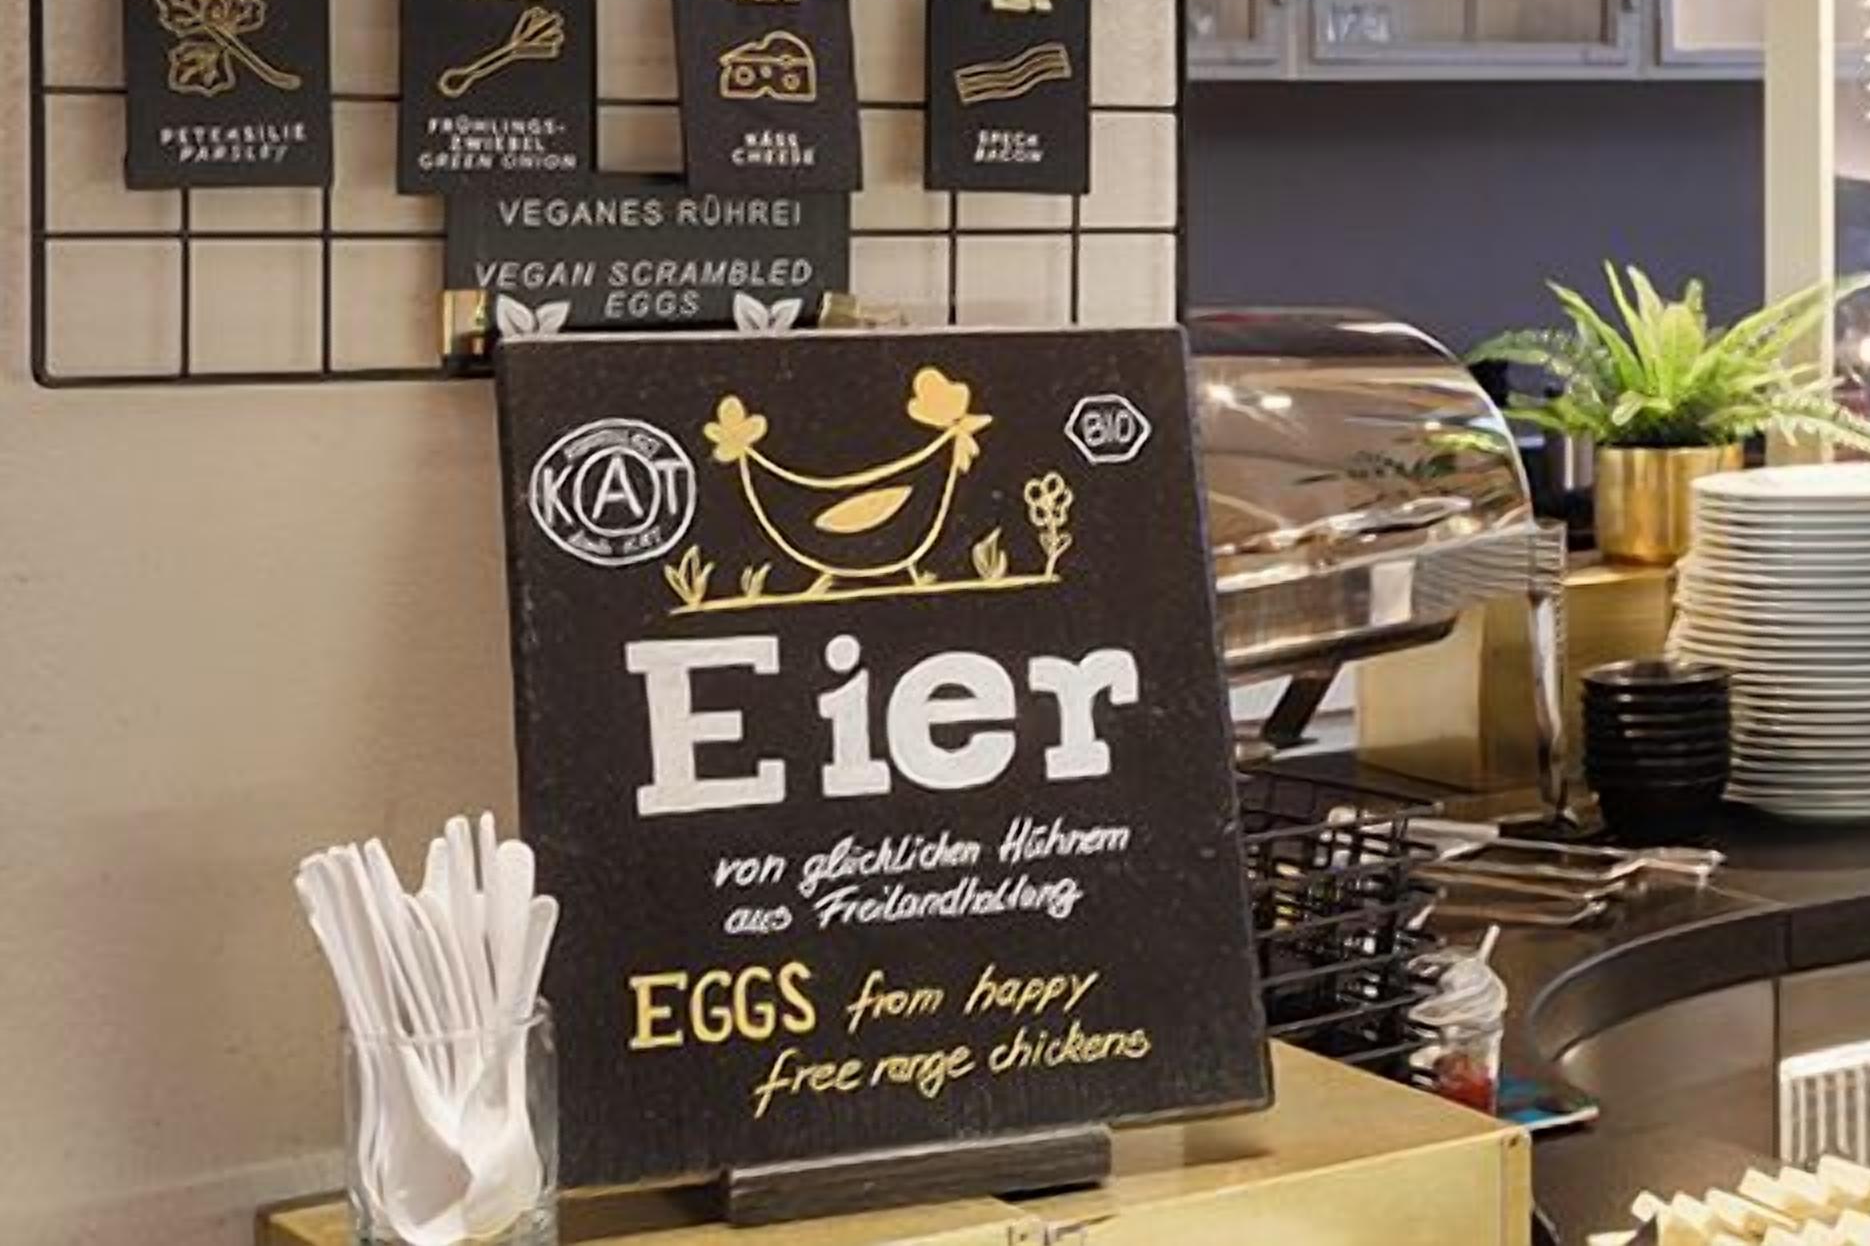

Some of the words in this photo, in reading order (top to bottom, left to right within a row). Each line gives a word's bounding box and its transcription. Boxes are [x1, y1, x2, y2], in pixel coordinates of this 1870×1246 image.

[499, 198, 664, 229] VEGANES
[676, 193, 800, 227] RÜHREI
[474, 261, 597, 289] VEGAN
[608, 258, 814, 288] SCRAMBLED
[603, 290, 702, 320] EGGS
[1080, 408, 1137, 448] BIO
[625, 634, 1140, 816] Eier
[714, 854, 787, 887] von
[724, 905, 793, 935] aus
[628, 961, 817, 1050] EGGS
[847, 969, 944, 1035] from
[964, 962, 1098, 1017] happy
[754, 1047, 863, 1120] free
[869, 1044, 977, 1098] range
[988, 1019, 1152, 1074] chickens
